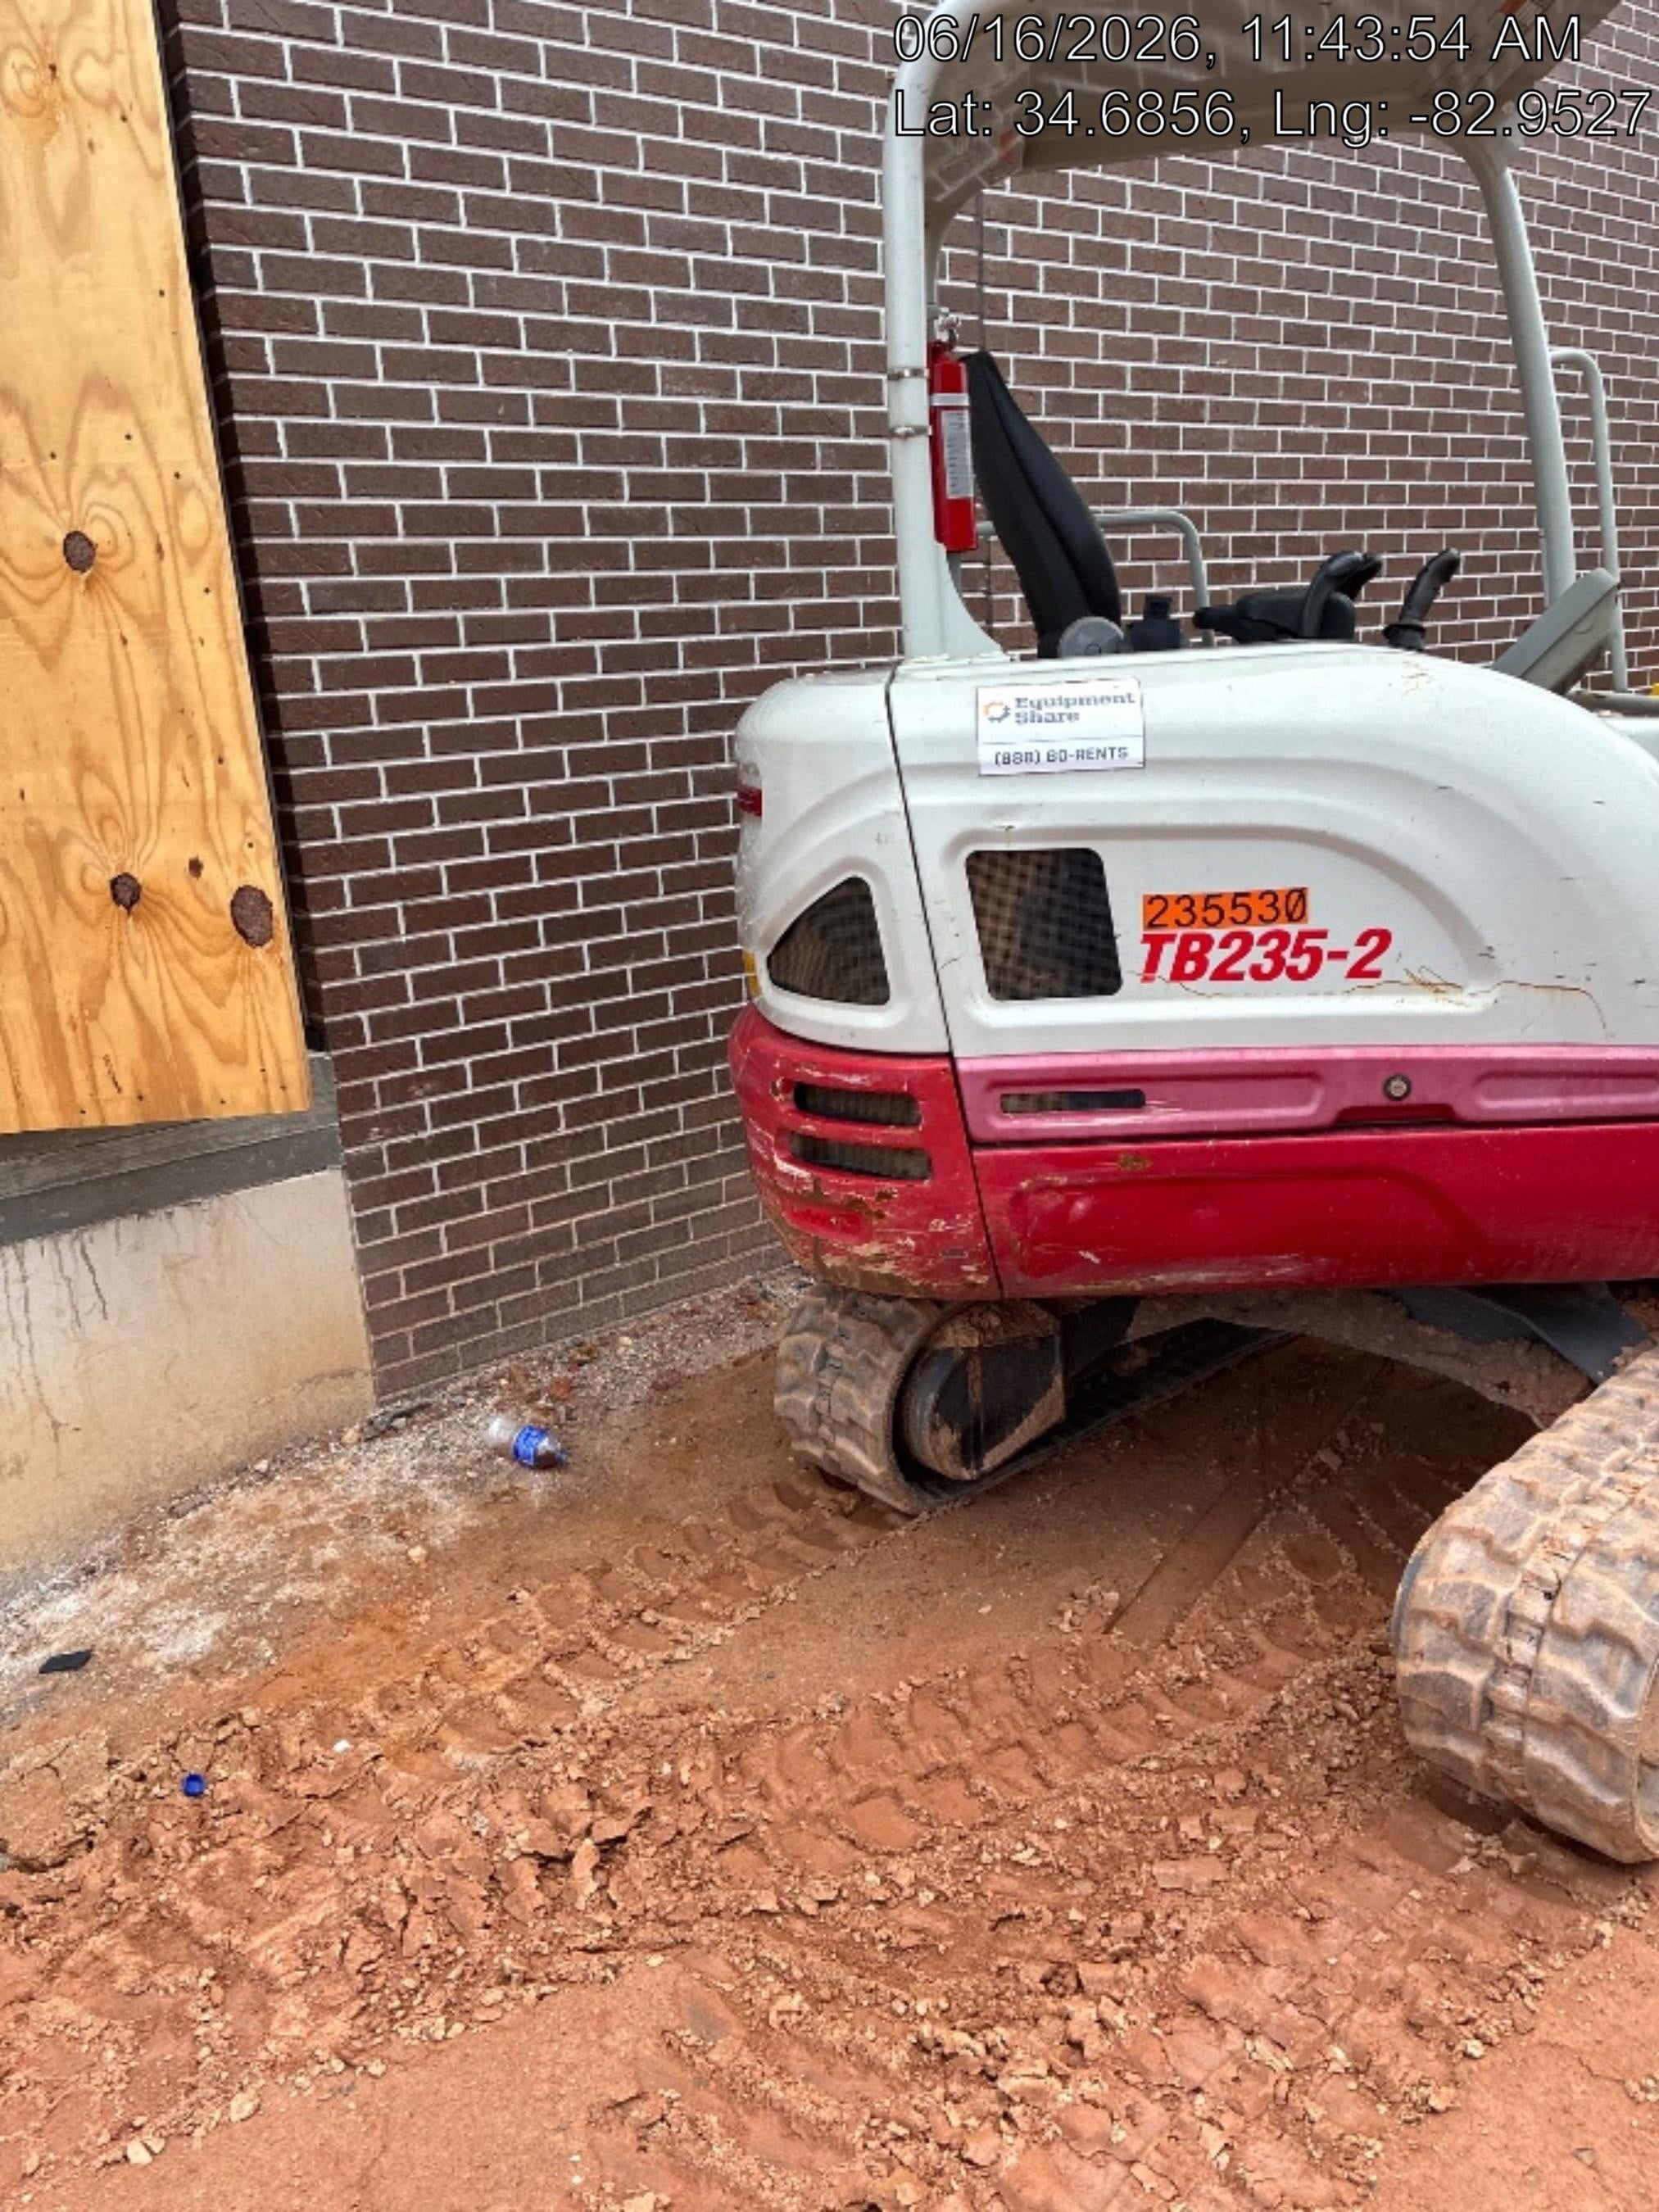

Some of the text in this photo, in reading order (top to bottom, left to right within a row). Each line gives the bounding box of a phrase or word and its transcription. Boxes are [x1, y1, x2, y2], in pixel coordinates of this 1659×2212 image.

[1015, 692, 1136, 711] Equipment
[1015, 710, 1080, 726] Share
[1147, 887, 1307, 927] 235530
[1140, 928, 1393, 983] TB235-2
